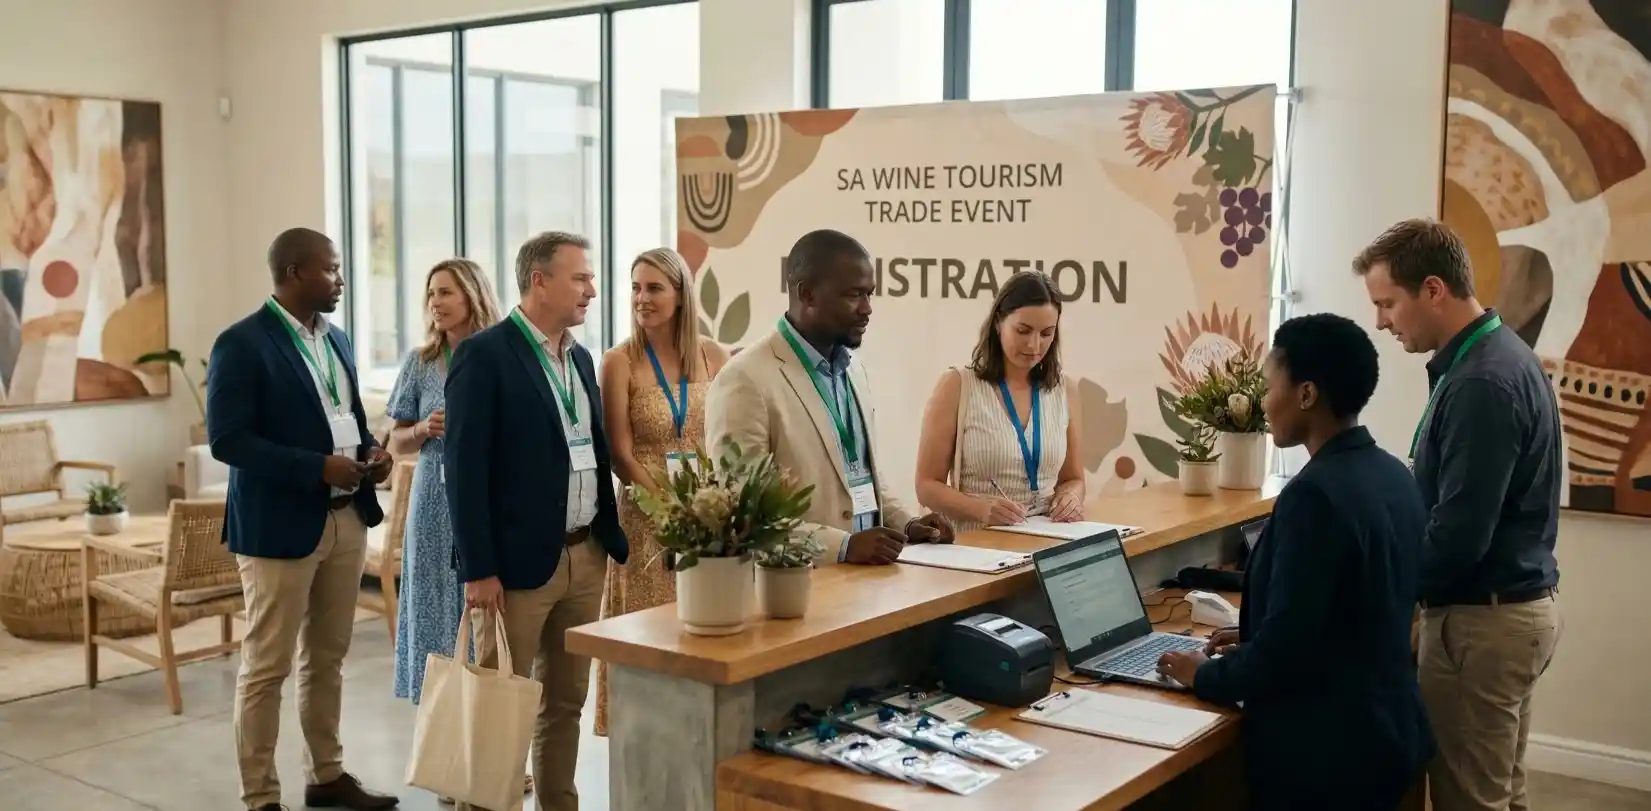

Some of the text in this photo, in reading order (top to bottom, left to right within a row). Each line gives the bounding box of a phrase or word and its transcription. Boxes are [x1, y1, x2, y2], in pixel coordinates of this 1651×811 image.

[837, 163, 1063, 191] SA WINE TOURISM
[864, 199, 1032, 223] TRADE EVENT
[781, 256, 1128, 304] ISTRATON
